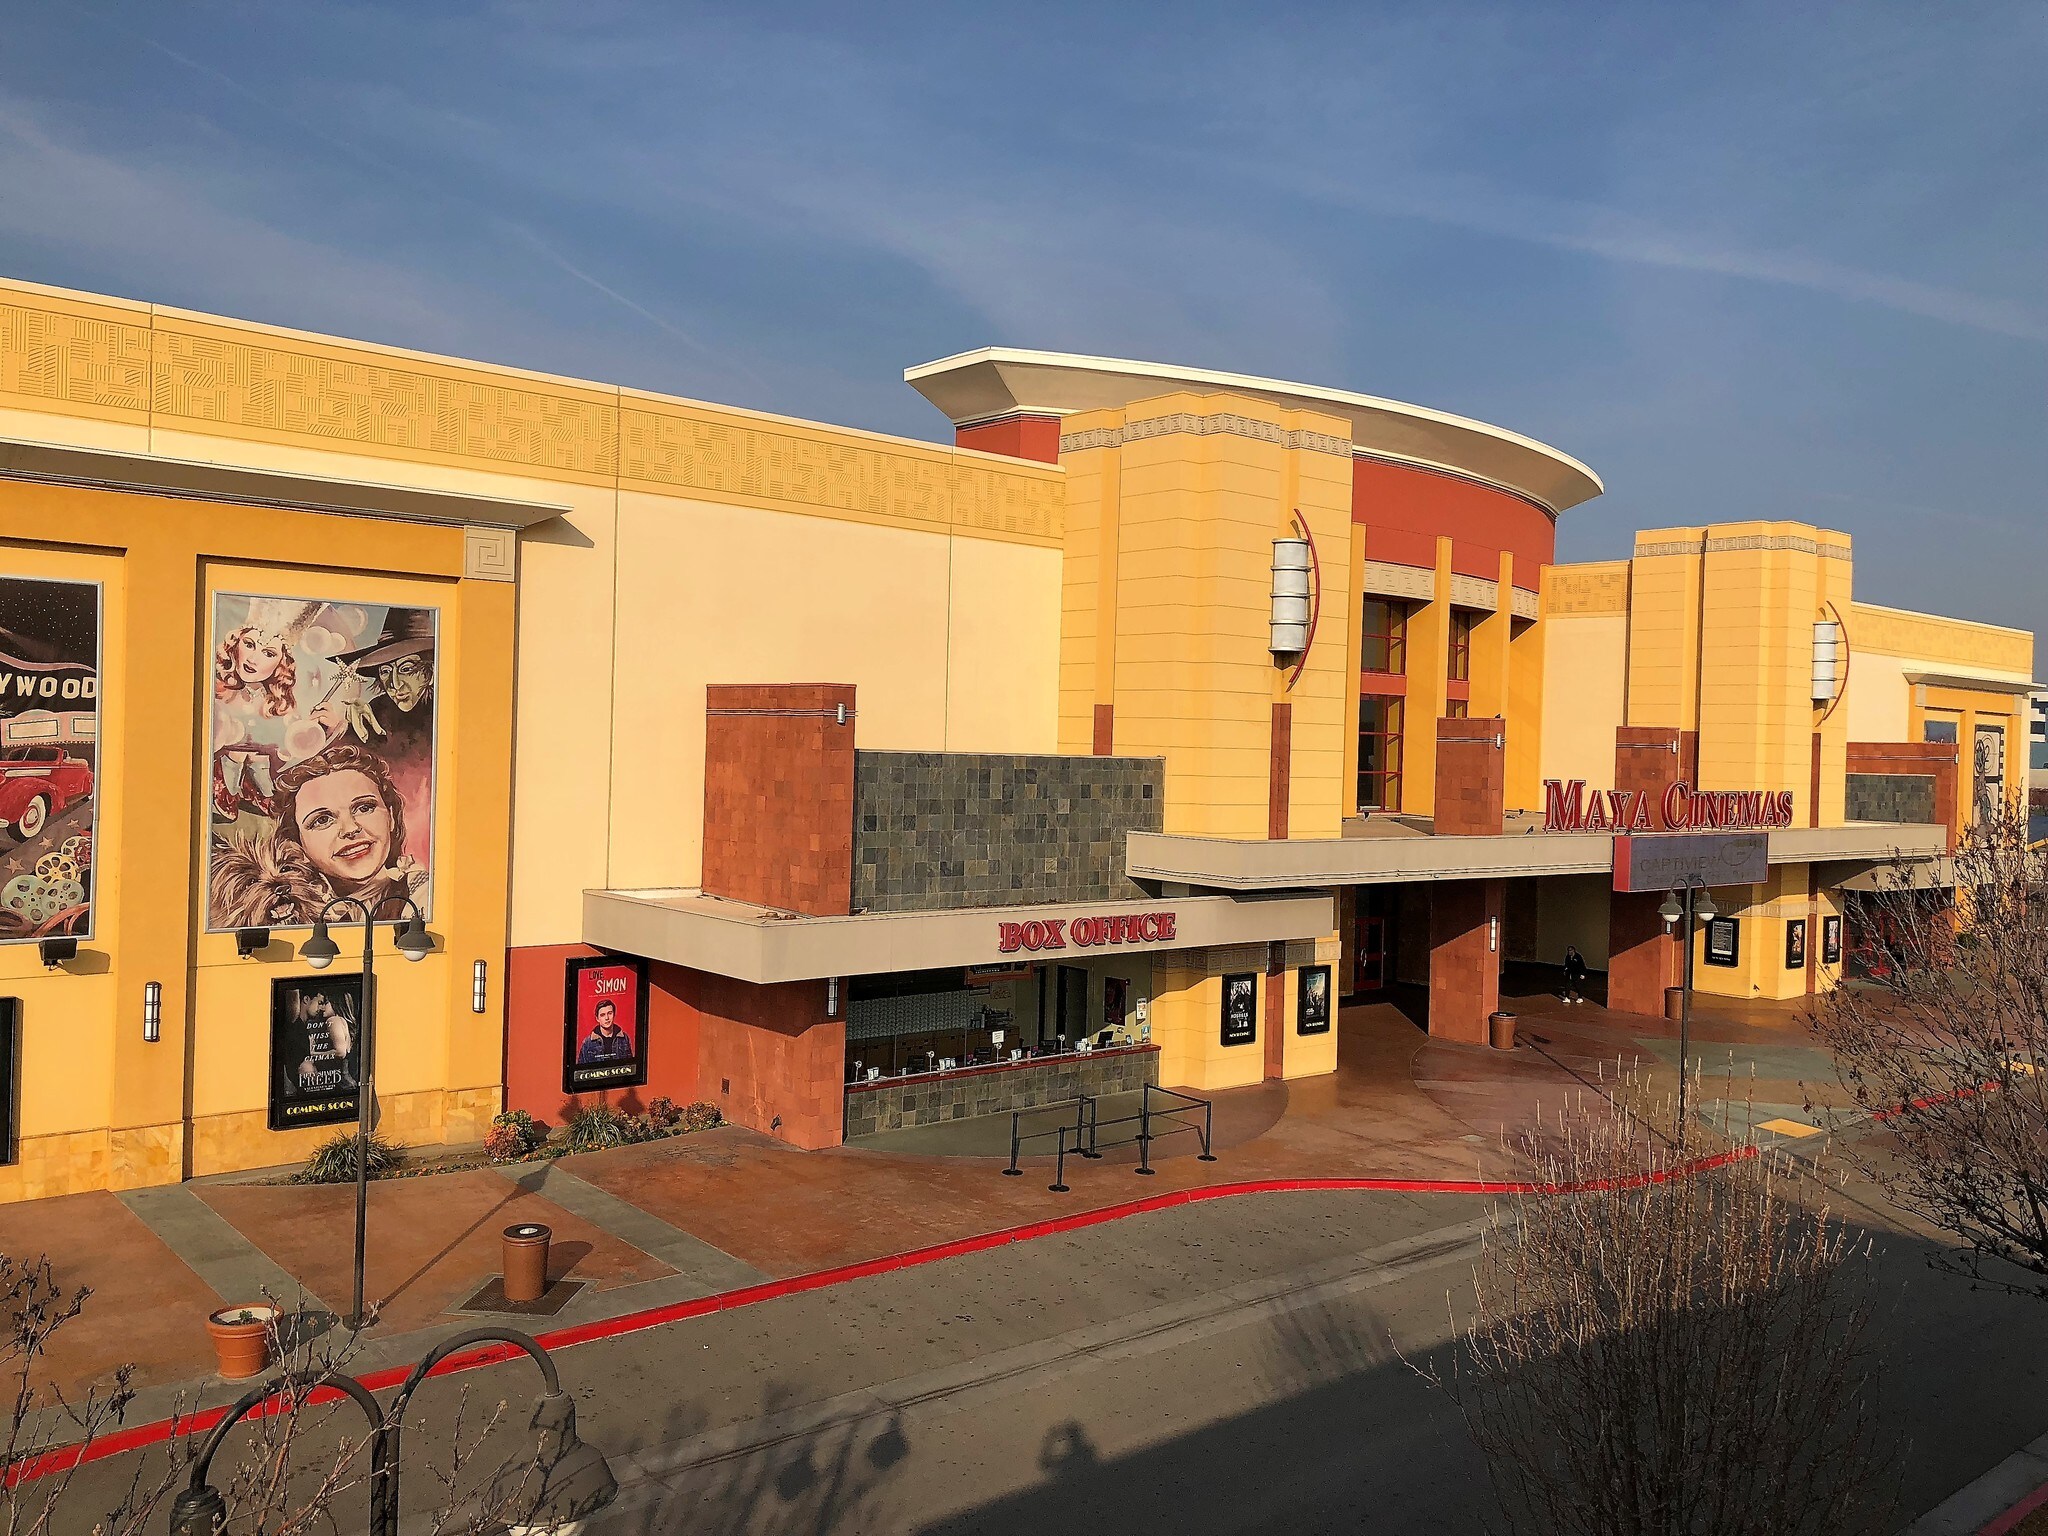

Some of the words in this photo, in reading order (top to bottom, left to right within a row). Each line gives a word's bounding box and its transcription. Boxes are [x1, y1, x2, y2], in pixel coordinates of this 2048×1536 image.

[999, 919, 1067, 953] BOX
[1070, 912, 1177, 947] OFFICE
[595, 977, 627, 994] SIMON
[306, 1021, 334, 1030] DON'T
[309, 1032, 331, 1040] MISS
[304, 1053, 336, 1062] CLIMAX
[299, 1073, 342, 1087] FREED
[580, 1069, 610, 1080] COMING
[611, 1067, 632, 1076] SOON
[286, 1104, 326, 1115] COMING
[327, 1100, 354, 1110] SOON
